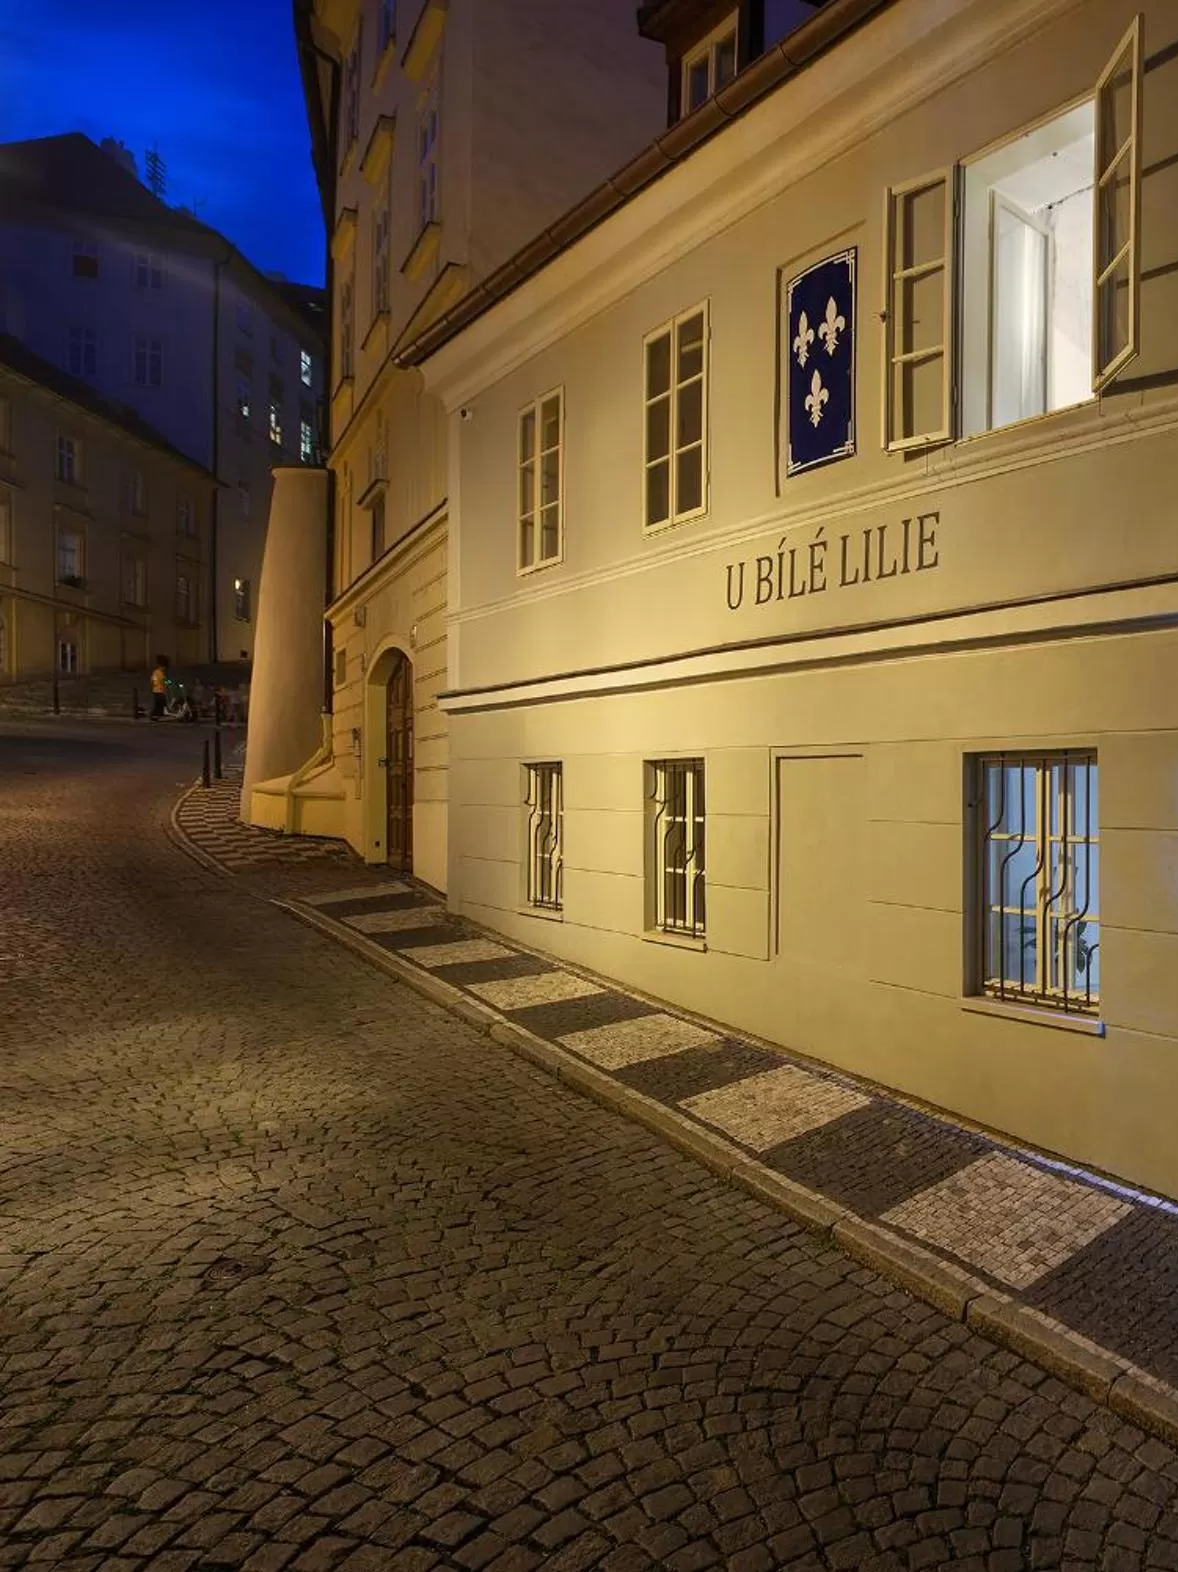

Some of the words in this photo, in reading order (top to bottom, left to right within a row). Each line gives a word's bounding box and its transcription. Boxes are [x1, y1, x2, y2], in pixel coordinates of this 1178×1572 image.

[726, 562, 745, 610] U
[755, 526, 828, 605] BÍLÉ
[839, 511, 940, 588] LILIE
